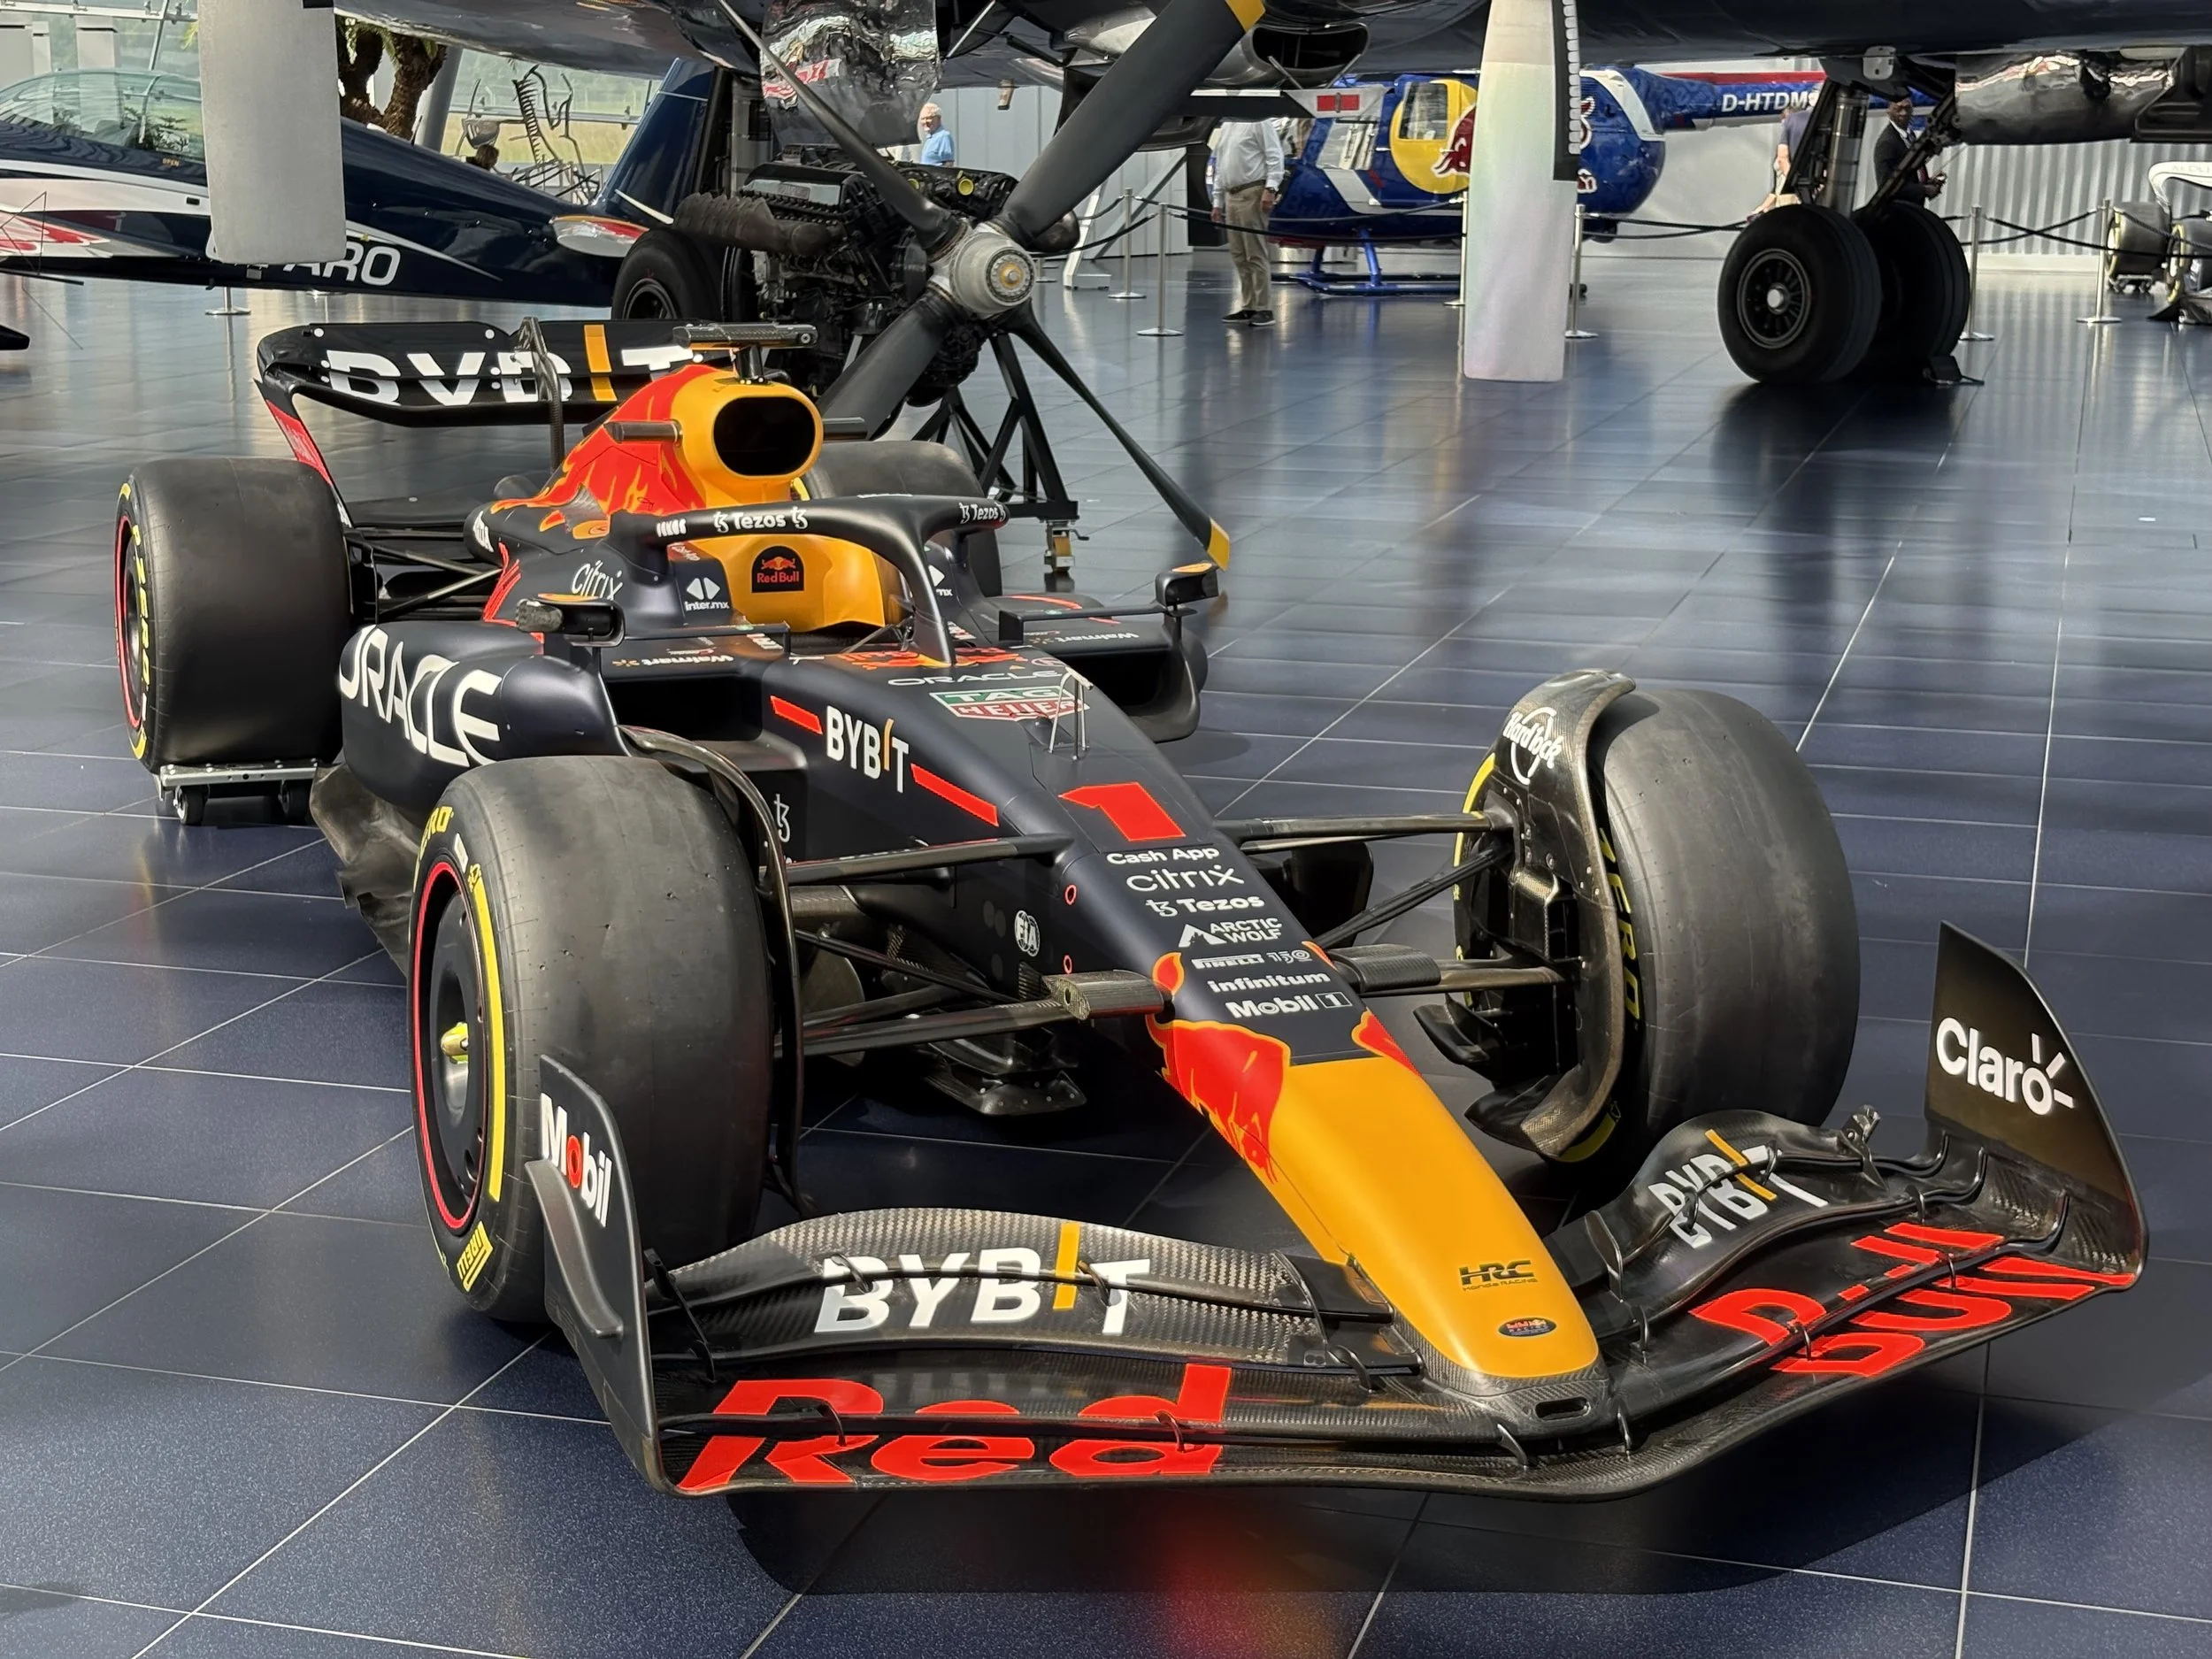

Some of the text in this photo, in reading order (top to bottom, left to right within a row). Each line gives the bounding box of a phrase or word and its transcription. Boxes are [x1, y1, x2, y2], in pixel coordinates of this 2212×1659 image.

[733, 511, 786, 530] Tezos
[971, 503, 999, 521] Tezos
[757, 571, 800, 583] Red Bull
[641, 655, 734, 666] Walmart
[887, 670, 1063, 686] ORACLE
[944, 688, 1055, 702] TAG
[956, 699, 1077, 718] HEUER
[826, 705, 910, 793] BYBIT
[1059, 782, 1186, 841] 1
[1106, 847, 1220, 865] Cash App
[1176, 895, 1265, 913] Tezos
[1210, 918, 1282, 933] ARCTIC
[1224, 929, 1282, 943] WOLF
[1191, 953, 1265, 970] PIRELLI
[1207, 973, 1331, 993] infinitum
[1225, 995, 1319, 1018] Mobil
[1936, 1018, 2056, 1116] Claro
[541, 1092, 613, 1228] Mobil
[1459, 1260, 1535, 1286] HRC
[676, 1362, 1232, 1491] Red
